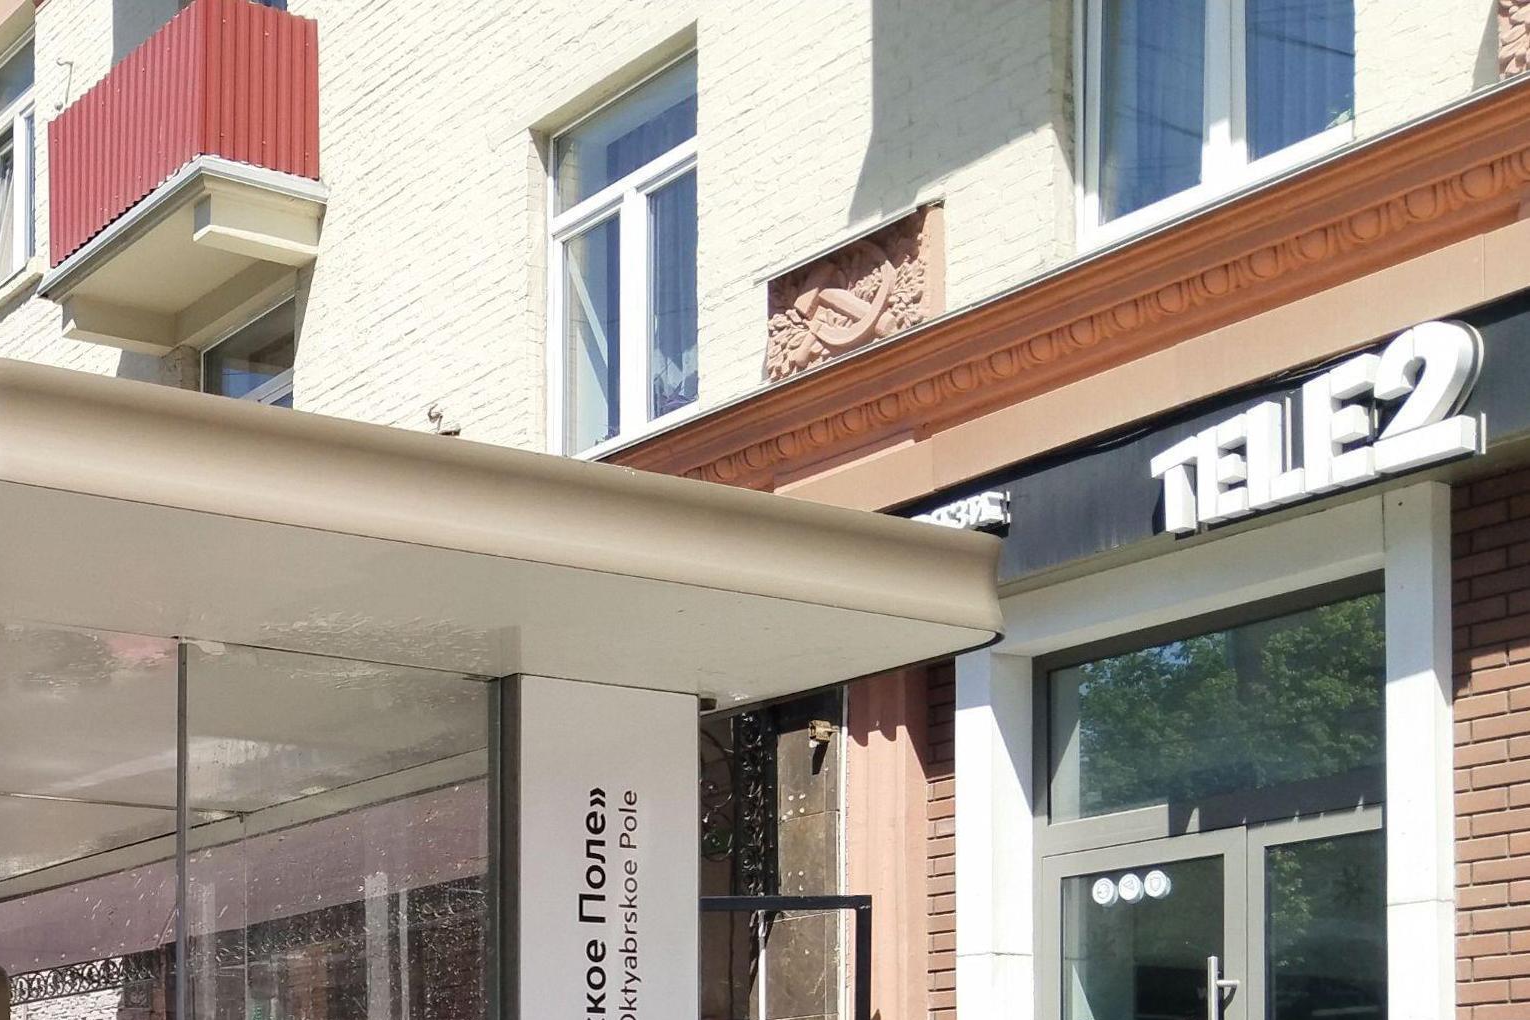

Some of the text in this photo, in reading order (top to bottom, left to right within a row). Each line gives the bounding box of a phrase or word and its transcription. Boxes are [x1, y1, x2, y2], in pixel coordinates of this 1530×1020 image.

[1151, 320, 1486, 535] TELE2
[579, 787, 606, 923] Поле»
[618, 790, 638, 849] Pole
